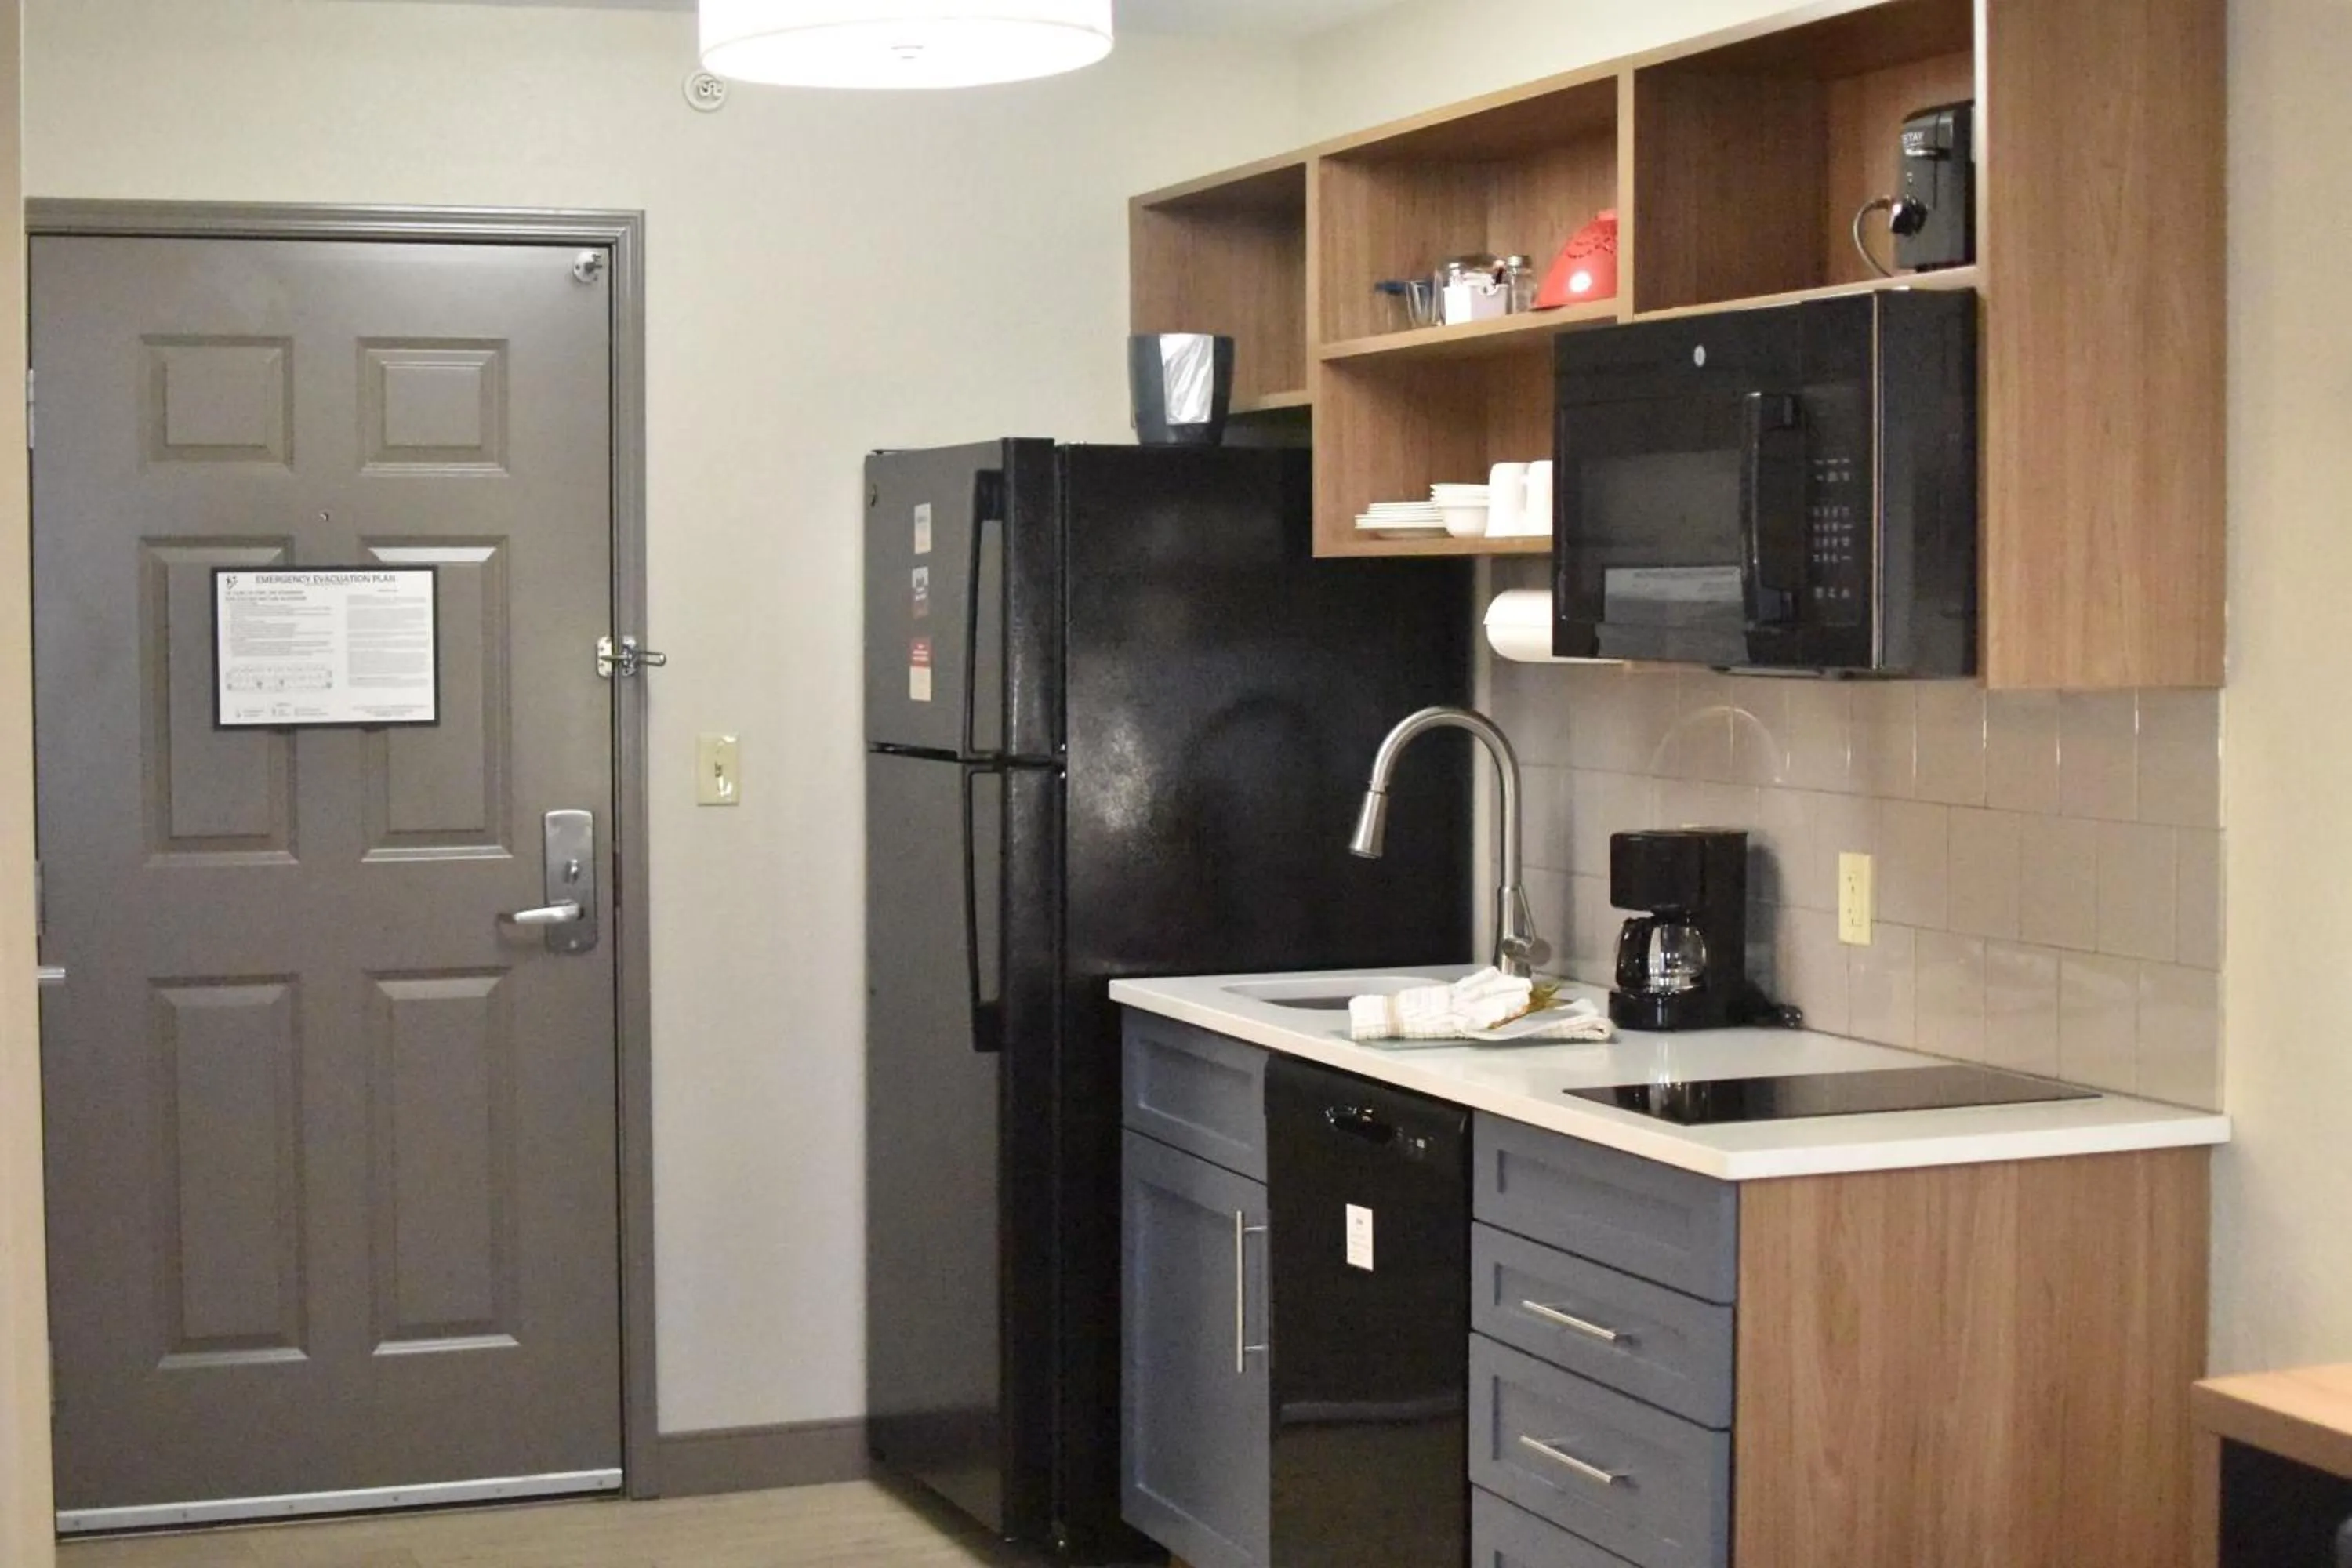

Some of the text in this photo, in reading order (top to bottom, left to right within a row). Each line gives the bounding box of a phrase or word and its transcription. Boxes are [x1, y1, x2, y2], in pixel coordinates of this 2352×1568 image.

[255, 574, 396, 584] EMERGENCY EVACUATION PLAN
